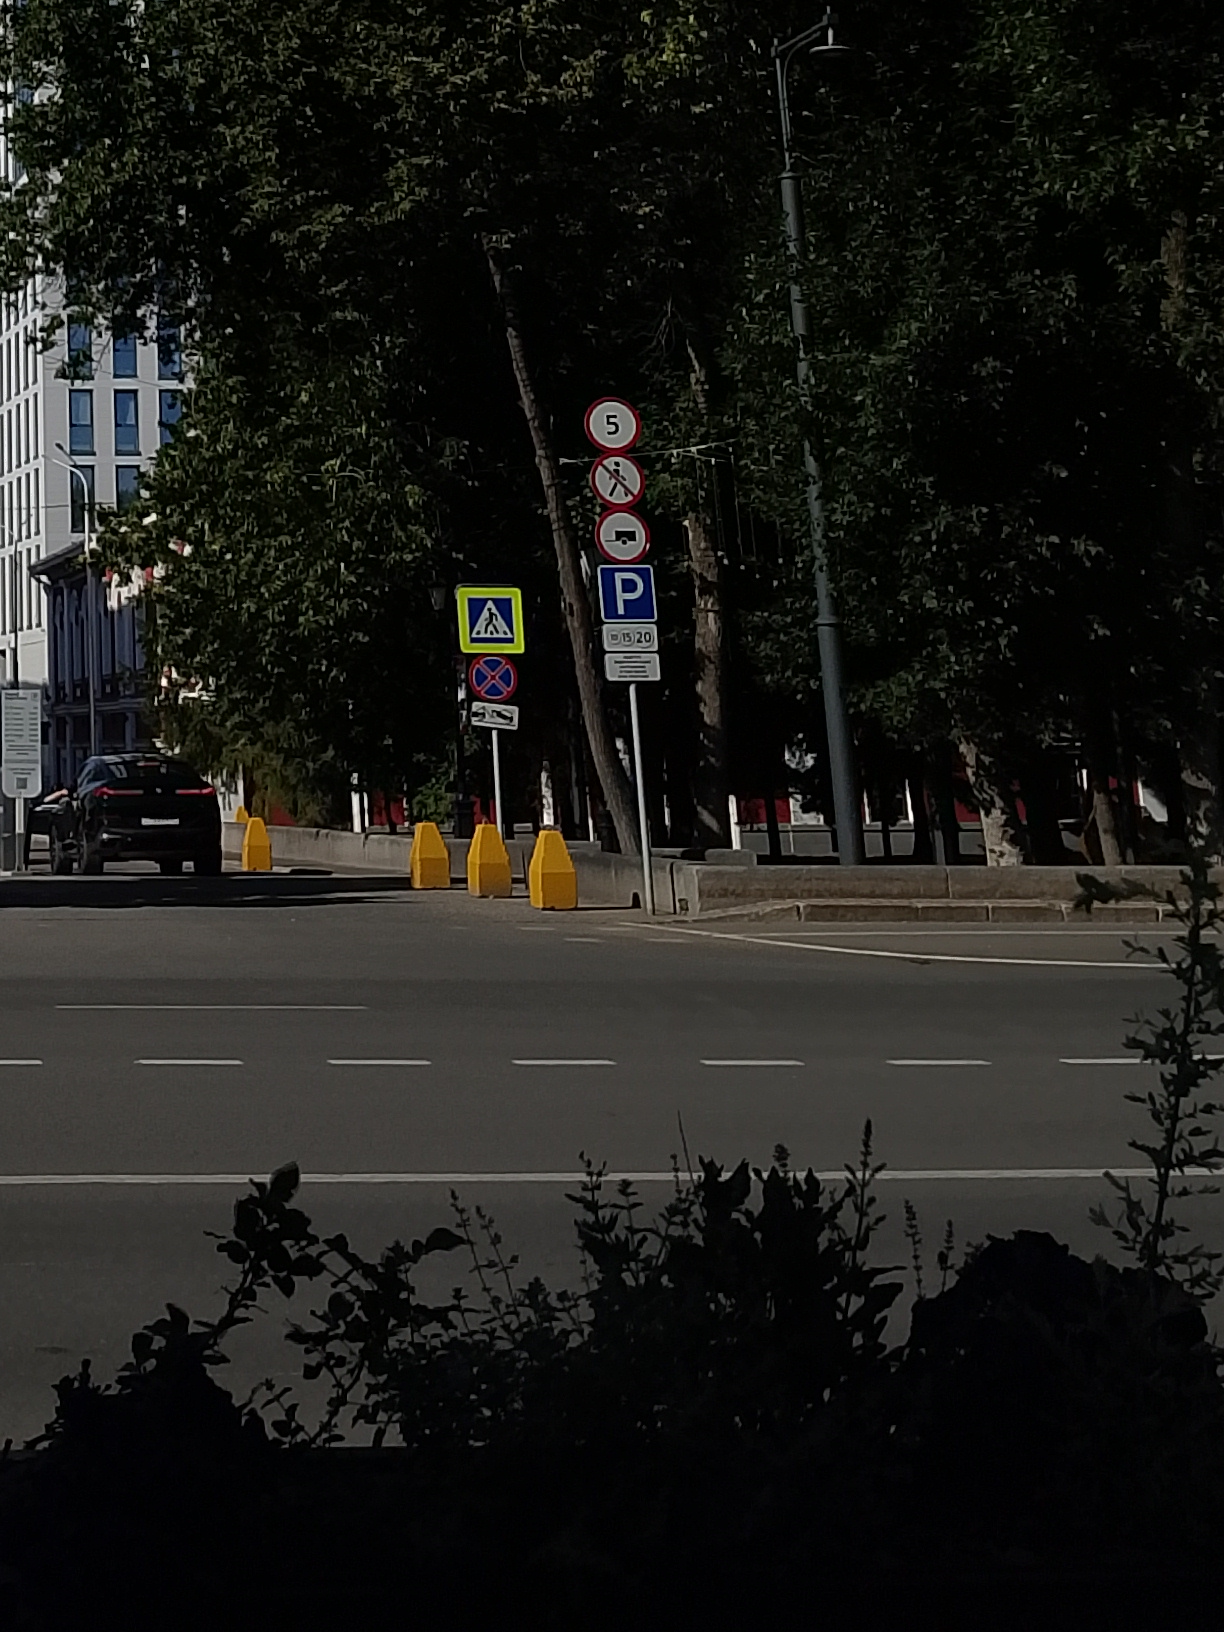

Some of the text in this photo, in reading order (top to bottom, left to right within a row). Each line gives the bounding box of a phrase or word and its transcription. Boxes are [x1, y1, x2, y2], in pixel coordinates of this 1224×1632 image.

[606, 415, 619, 435] 5
[615, 572, 643, 615] P
[622, 632, 632, 643] 15
[636, 631, 651, 643] 20
